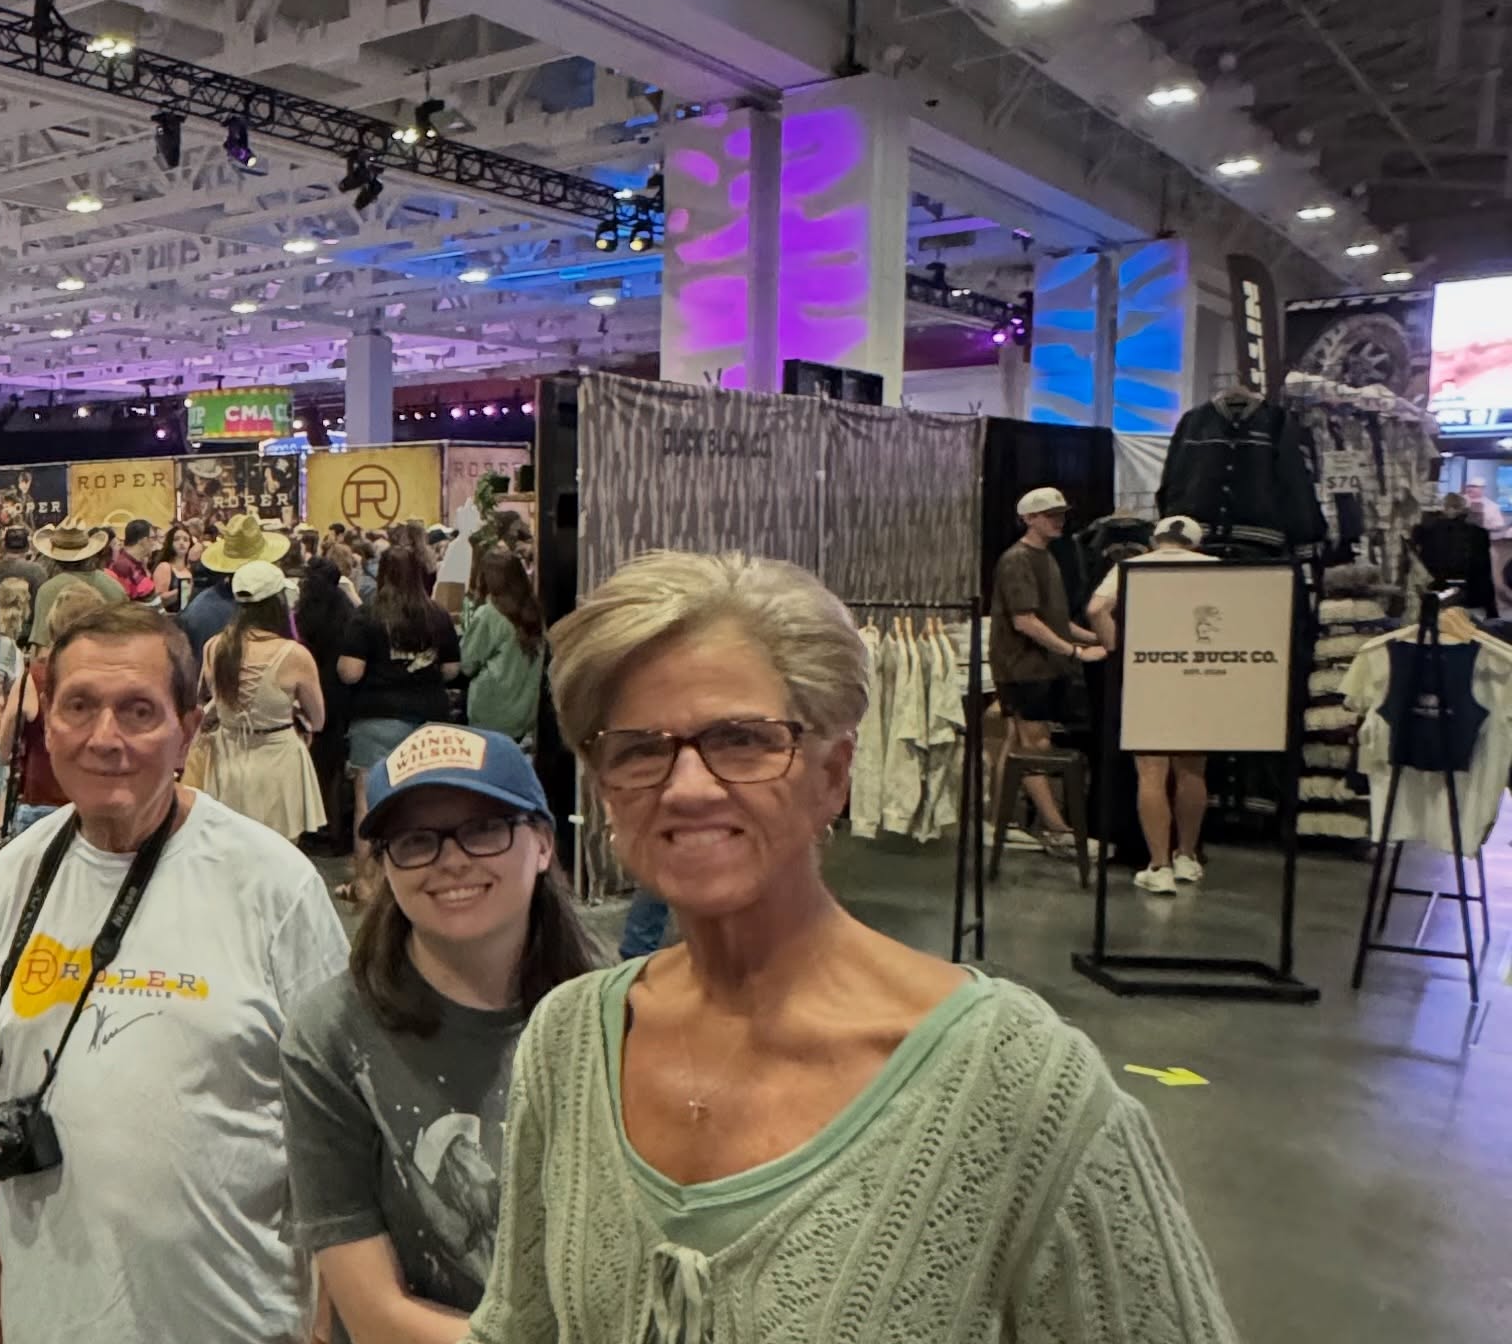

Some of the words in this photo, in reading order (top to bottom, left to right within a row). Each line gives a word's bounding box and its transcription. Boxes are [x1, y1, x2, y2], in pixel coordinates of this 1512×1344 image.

[1242, 280, 1268, 400] NITT
[225, 405, 273, 422] CMA
[77, 472, 167, 489] ROPER
[213, 492, 289, 509] ROPER
[1133, 650, 1189, 664] DUCK
[1192, 650, 1248, 664] BUCK
[1250, 650, 1279, 664] CO.
[399, 735, 465, 758] LAINEY
[396, 747, 471, 770] WILSON
[60, 962, 198, 992] ROPER
[97, 987, 172, 998] ASHVILLE
